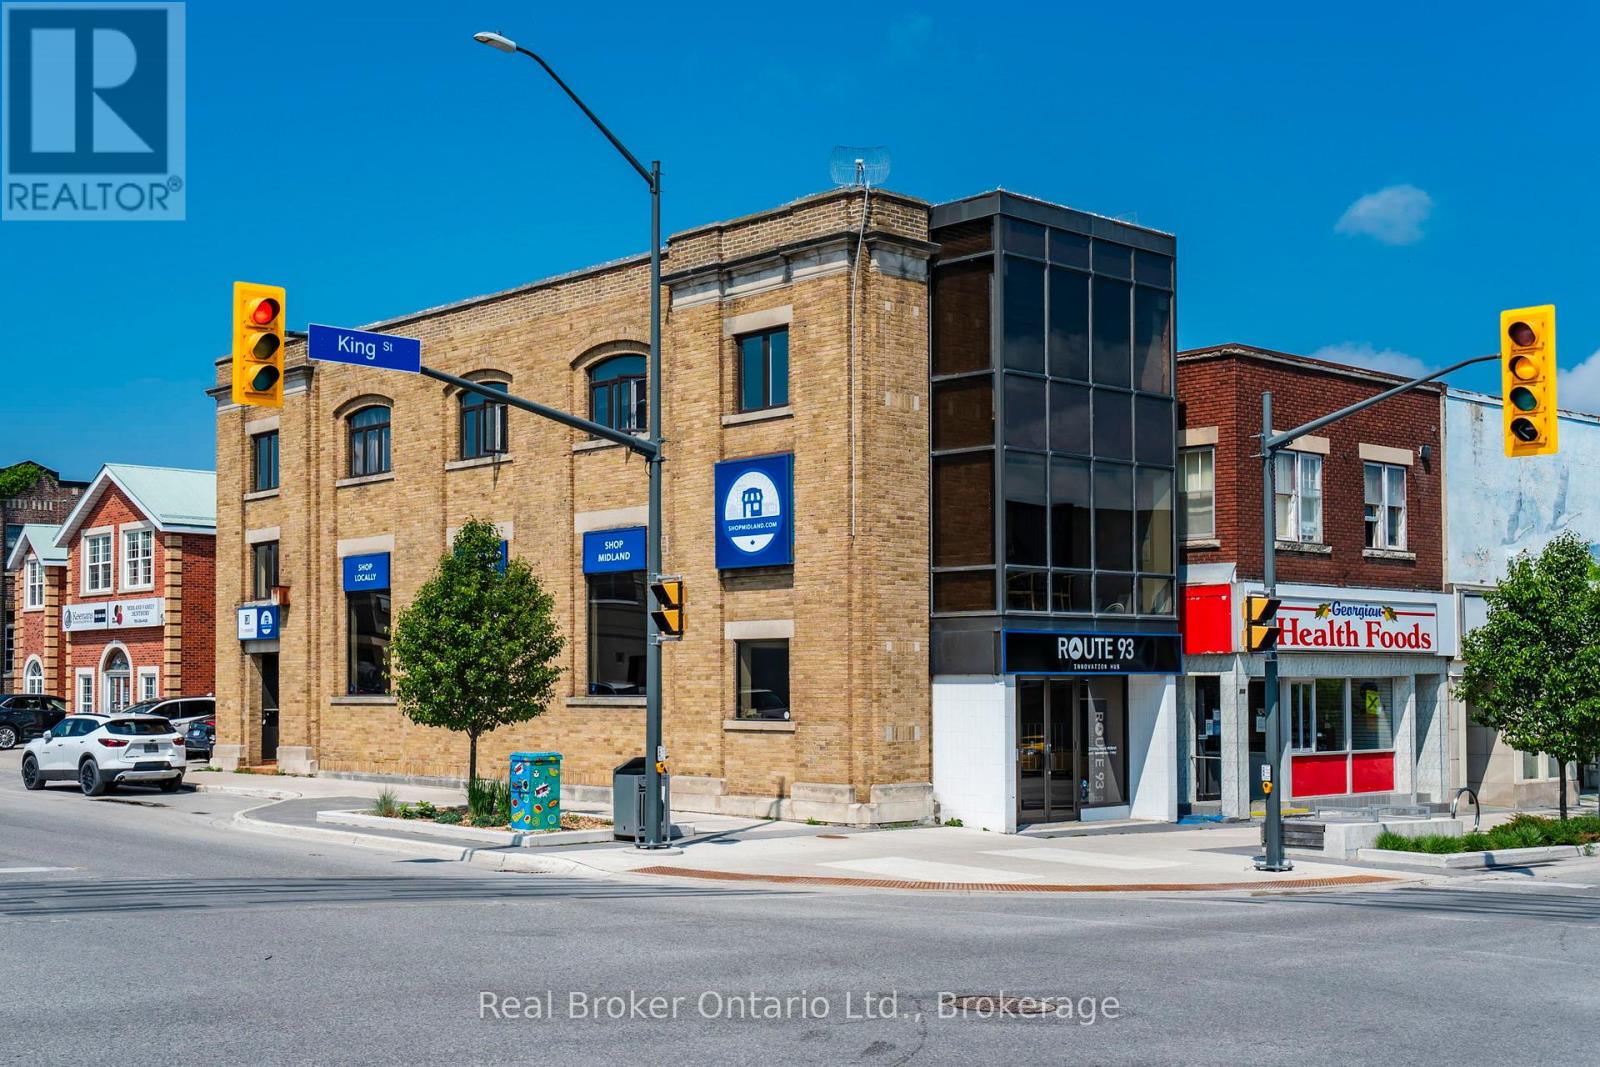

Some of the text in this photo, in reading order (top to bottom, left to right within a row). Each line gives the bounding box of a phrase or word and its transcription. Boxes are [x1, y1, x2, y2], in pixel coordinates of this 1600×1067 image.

[338, 335, 393, 360] King St
[728, 521, 777, 532] SHOPMIDLAND.COM
[604, 540, 624, 550] SHOP
[598, 551, 631, 562] MIDLAND
[358, 563, 373, 571] SHOP
[354, 573, 377, 582] LOCALLY
[1331, 600, 1382, 620] Georgian
[1276, 617, 1432, 649] Health Foods
[1058, 637, 1135, 660] ROUTE 93
